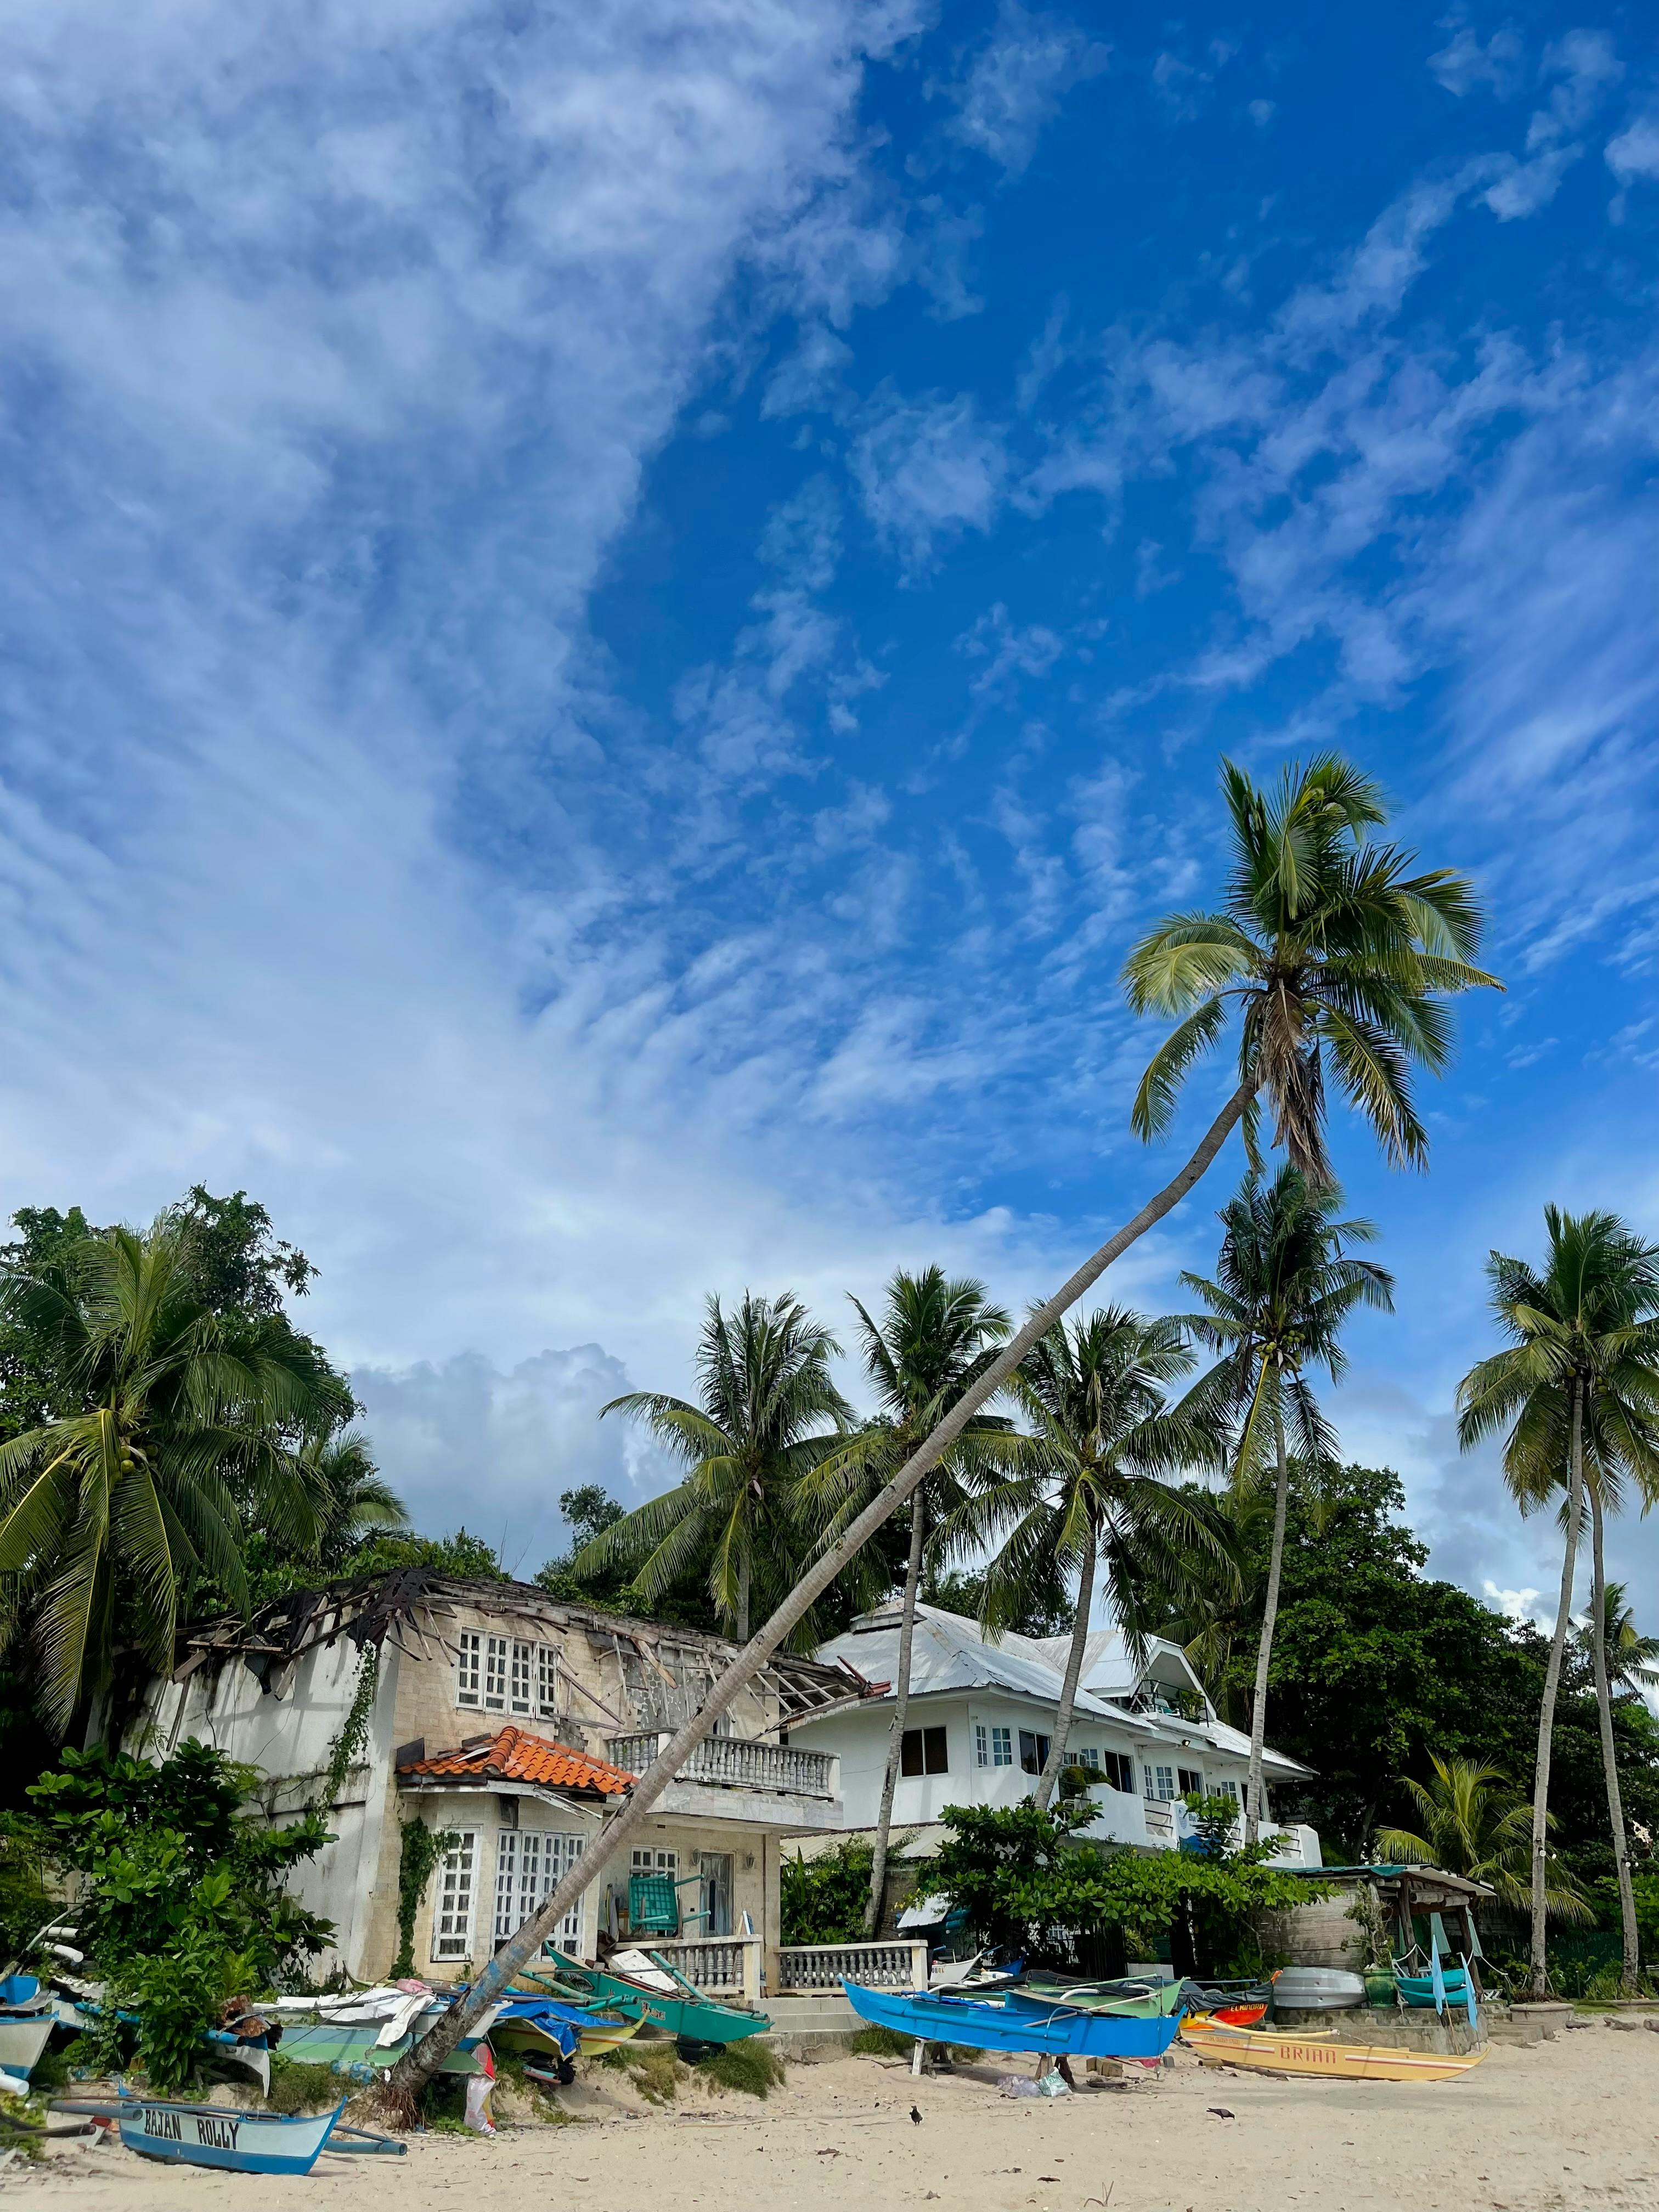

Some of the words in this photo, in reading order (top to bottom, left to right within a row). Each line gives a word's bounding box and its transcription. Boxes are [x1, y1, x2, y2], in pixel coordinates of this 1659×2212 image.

[1280, 2045, 1335, 2063] BRIAN
[145, 2109, 182, 2140] BAJAN
[197, 2119, 239, 2149] ROLLY
